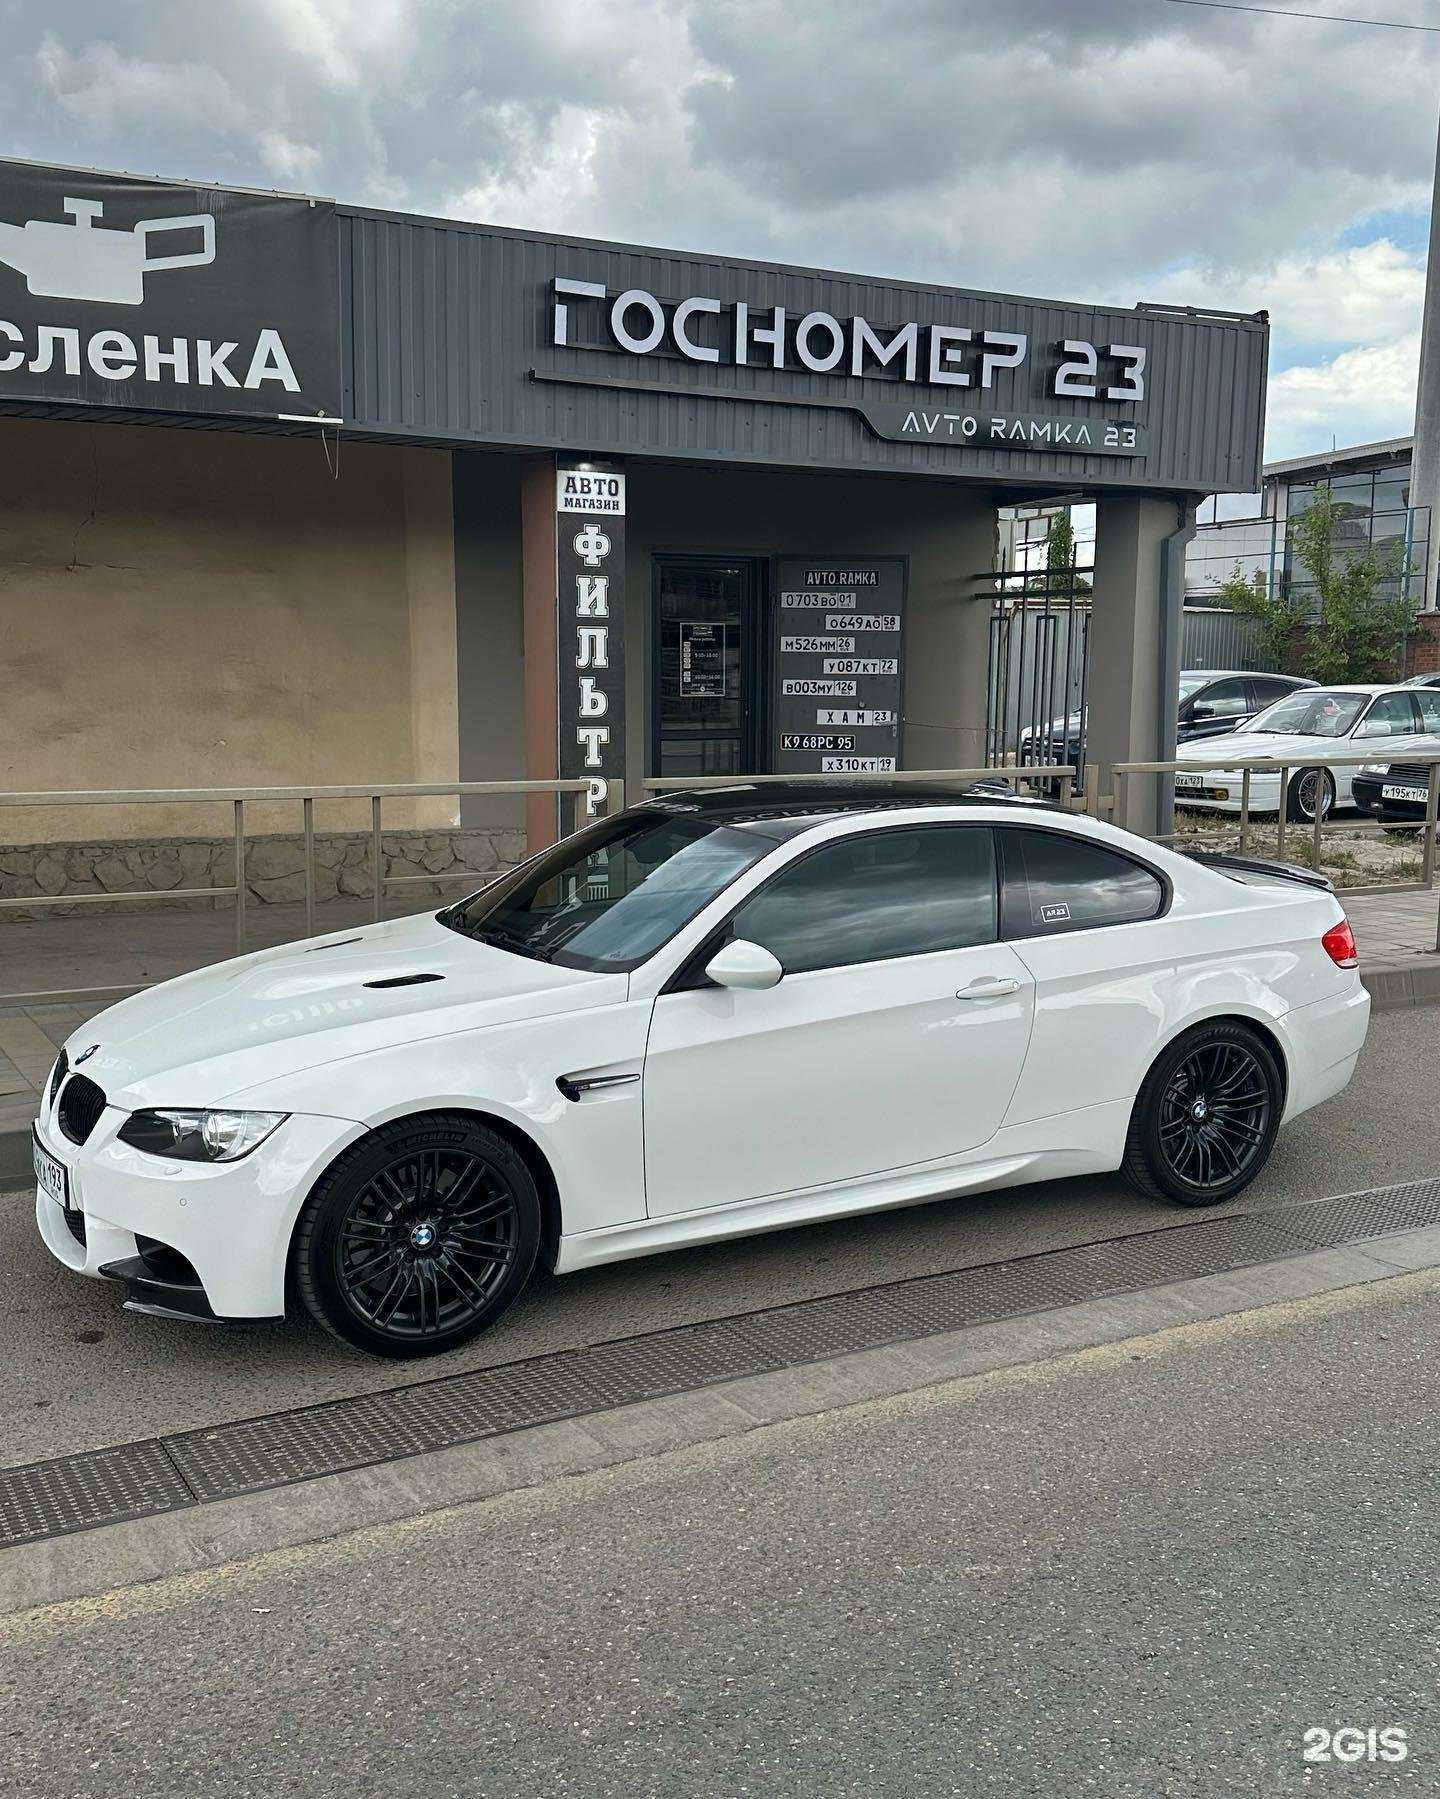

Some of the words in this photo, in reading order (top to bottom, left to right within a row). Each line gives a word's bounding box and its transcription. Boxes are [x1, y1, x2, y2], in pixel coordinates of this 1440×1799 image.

[553, 277, 1027, 389] ГОСНОМЕР
[1054, 340, 1146, 401] 23
[901, 411, 978, 437] AVTO
[990, 418, 1092, 446] RAMKA
[1103, 426, 1137, 448] 23
[564, 476, 620, 497] АВТО
[564, 497, 620, 511] МАГАЗИН
[806, 572, 836, 585] AVTO
[839, 572, 877, 585] RAMKA
[883, 616, 896, 626] 58
[838, 637, 851, 648] 26
[881, 660, 893, 670] 72
[874, 711, 887, 721] 23
